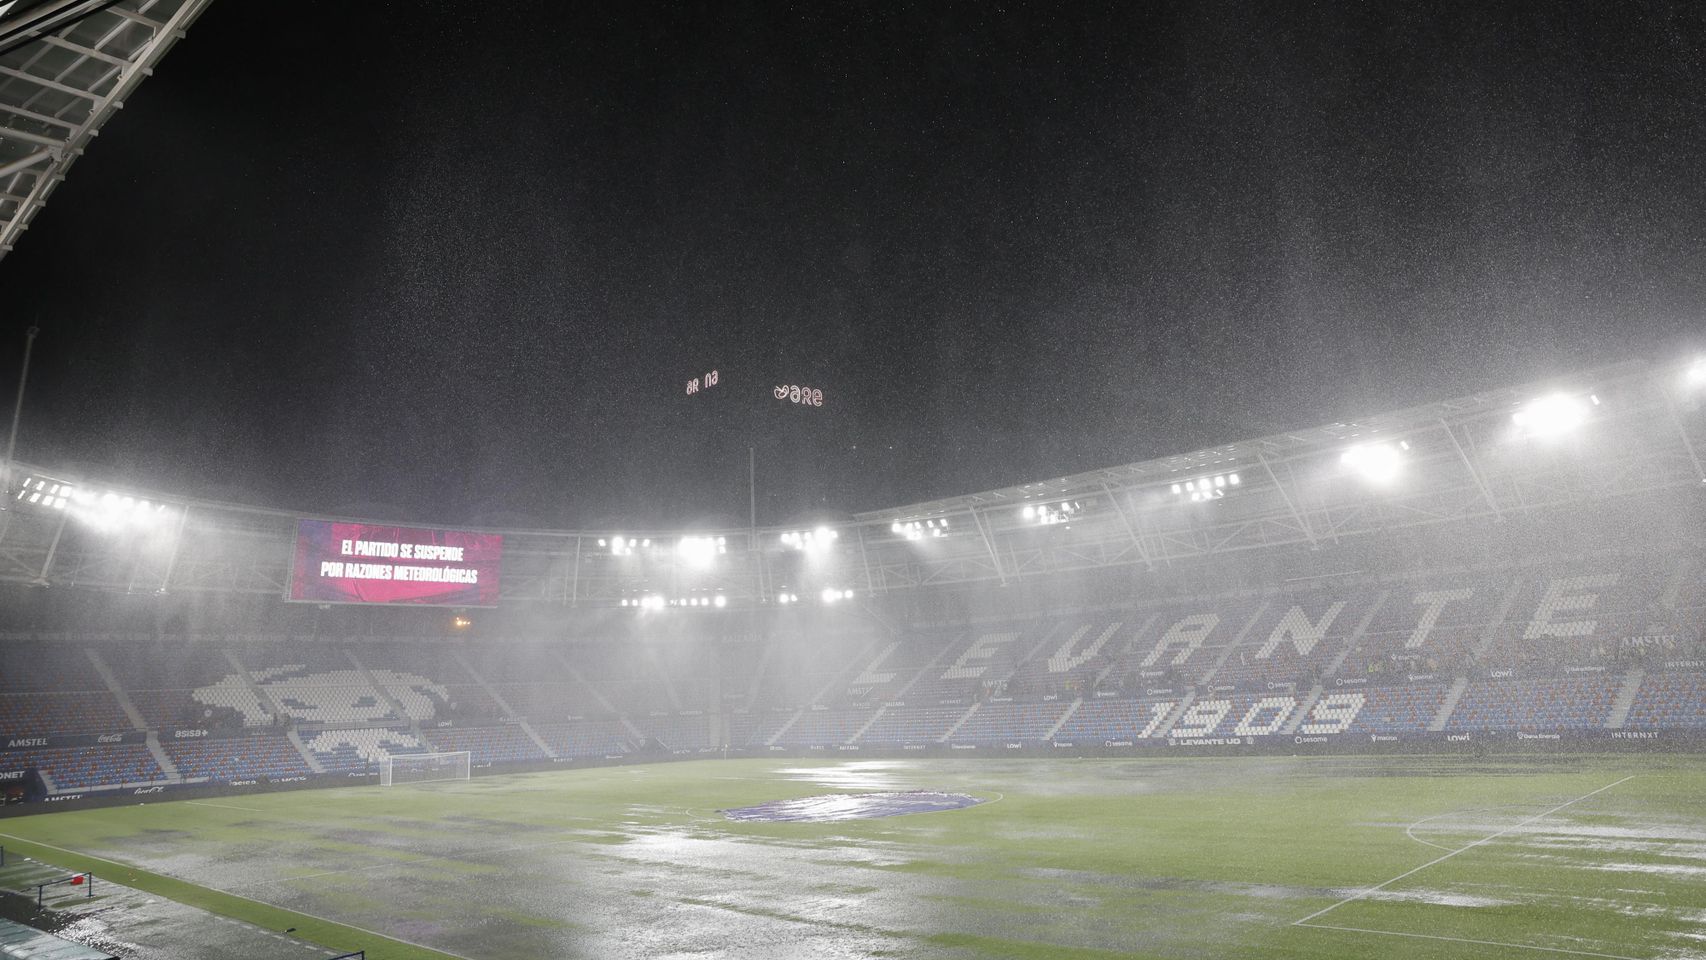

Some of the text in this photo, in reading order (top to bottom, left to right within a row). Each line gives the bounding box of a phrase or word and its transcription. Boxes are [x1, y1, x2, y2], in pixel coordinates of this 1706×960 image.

[341, 540, 464, 562] EL PARTIDO SE SUSPENDE
[320, 561, 478, 584] POR RAZONES METEOROLÓGICAS
[1137, 692, 1367, 739] 1909
[8, 738, 48, 748] AMSTEL
[1180, 738, 1224, 746] LEVANTE
